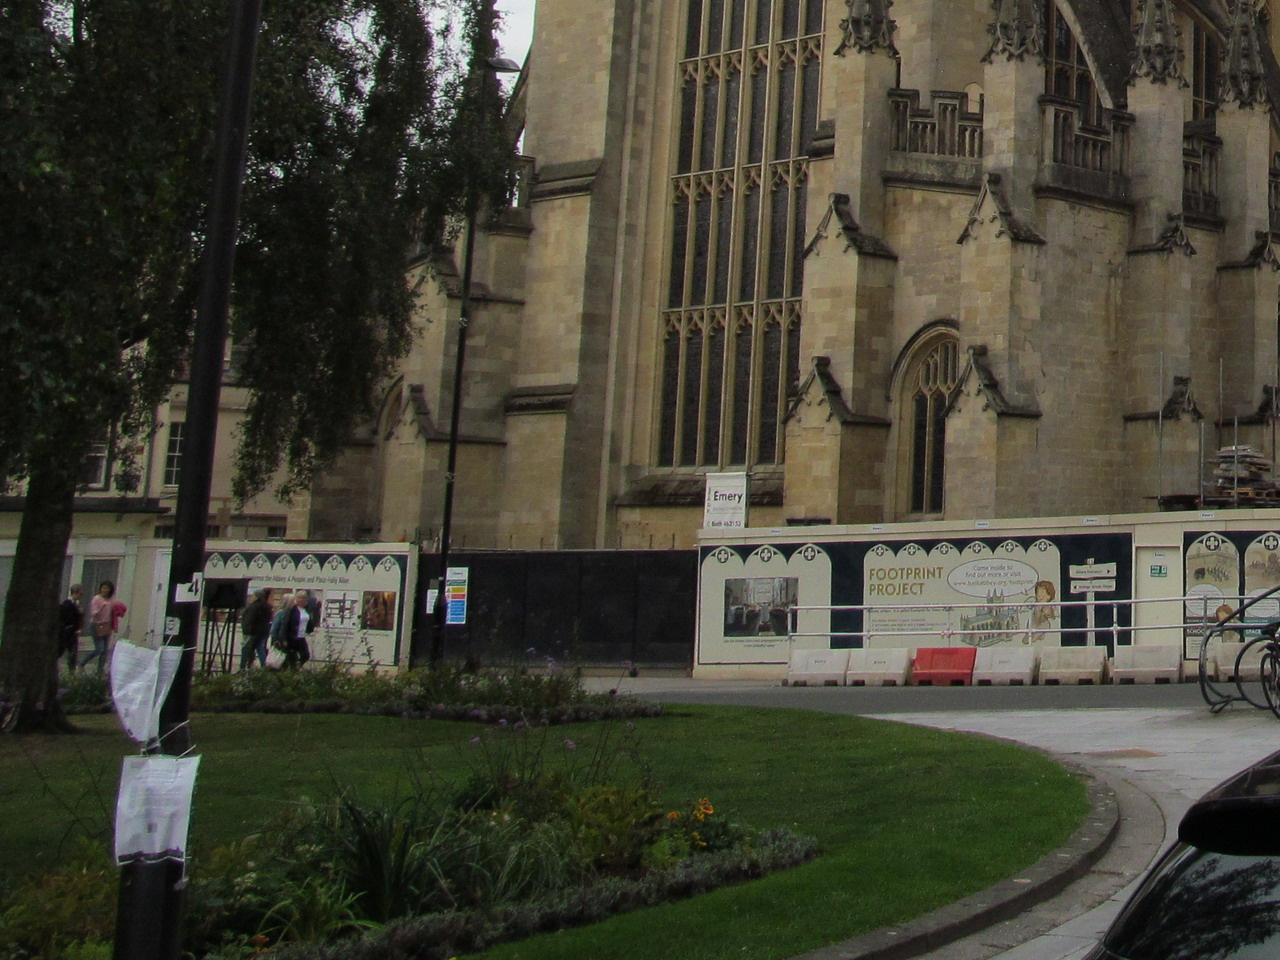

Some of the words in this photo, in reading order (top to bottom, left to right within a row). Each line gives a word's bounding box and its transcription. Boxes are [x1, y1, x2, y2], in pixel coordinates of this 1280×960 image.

[713, 490, 743, 504] Emery
[869, 566, 944, 581] FOOTPRINT
[869, 583, 925, 596] PROJECT
